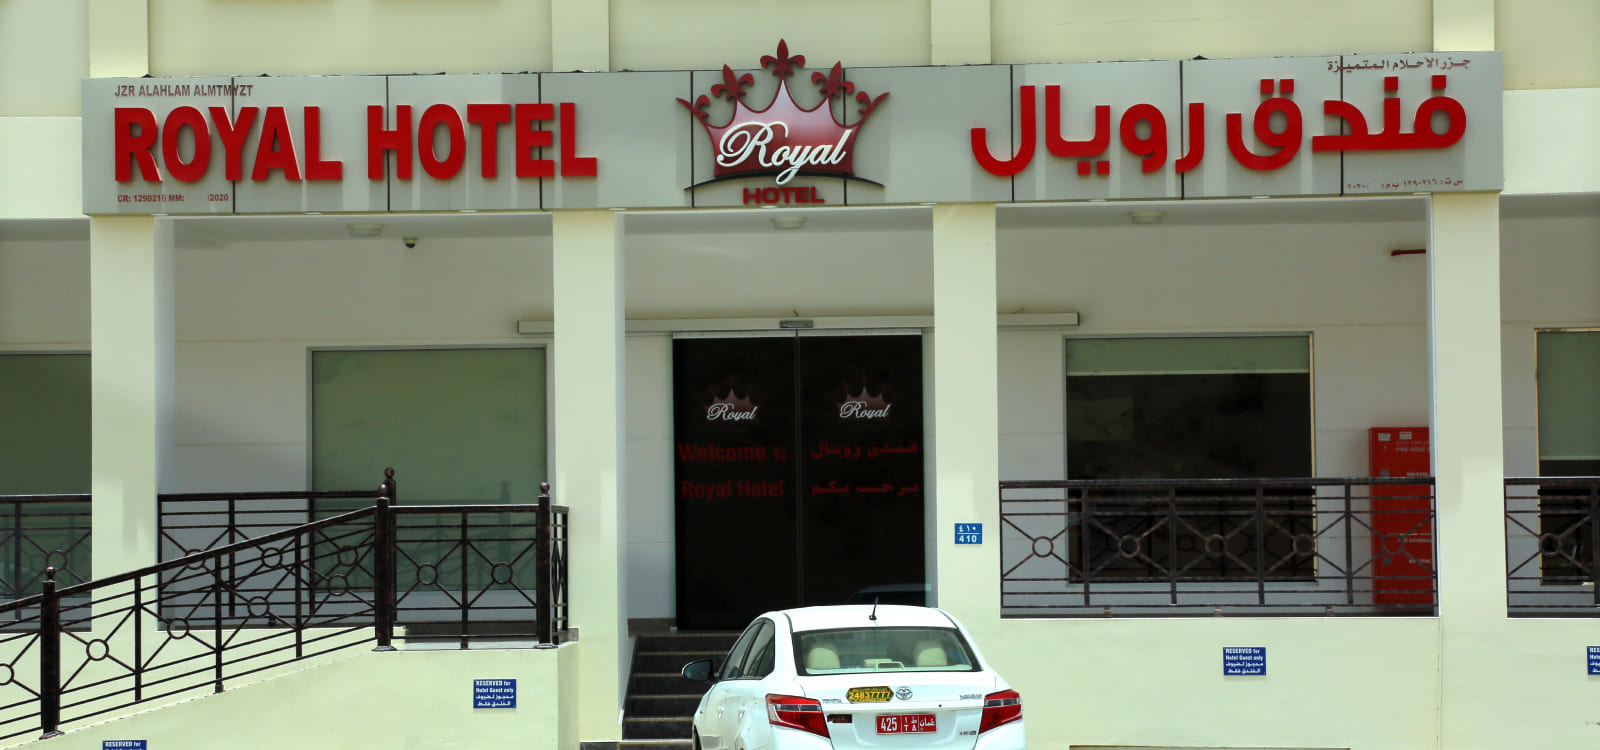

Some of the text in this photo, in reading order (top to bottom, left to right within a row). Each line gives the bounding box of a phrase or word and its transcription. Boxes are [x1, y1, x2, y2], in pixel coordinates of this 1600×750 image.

[114, 85, 253, 97] JZR ALAHLAM ALMTMYZT
[971, 74, 1467, 177] فندق رويال
[114, 102, 599, 183] ROYAL HOTEL
[716, 121, 853, 185] Royal
[117, 194, 132, 202] CR:
[168, 194, 185, 202] MM:
[743, 187, 825, 205] HOTEL
[678, 442, 767, 462] Welcome
[681, 480, 784, 501] Royal Hotel
[881, 717, 898, 731] 425
